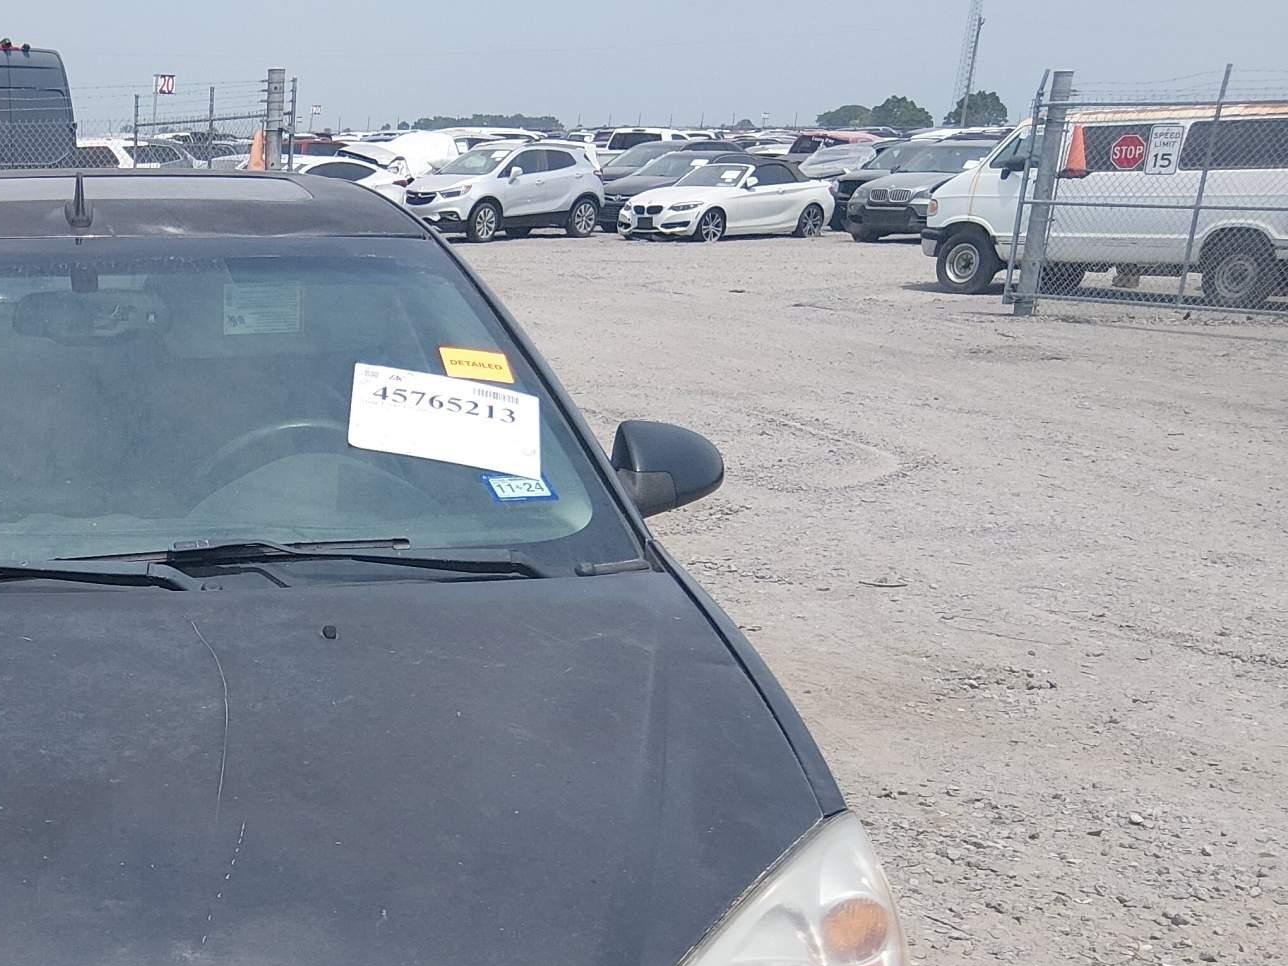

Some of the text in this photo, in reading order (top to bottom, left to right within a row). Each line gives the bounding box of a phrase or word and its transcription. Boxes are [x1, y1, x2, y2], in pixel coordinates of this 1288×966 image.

[159, 74, 175, 95] 20
[1153, 131, 1181, 139] SPEED
[1154, 140, 1178, 148] LIMIT
[1112, 145, 1144, 160] STOP
[1152, 152, 1173, 169] 15
[449, 359, 504, 371] DETAILED
[372, 385, 516, 424] 45765213
